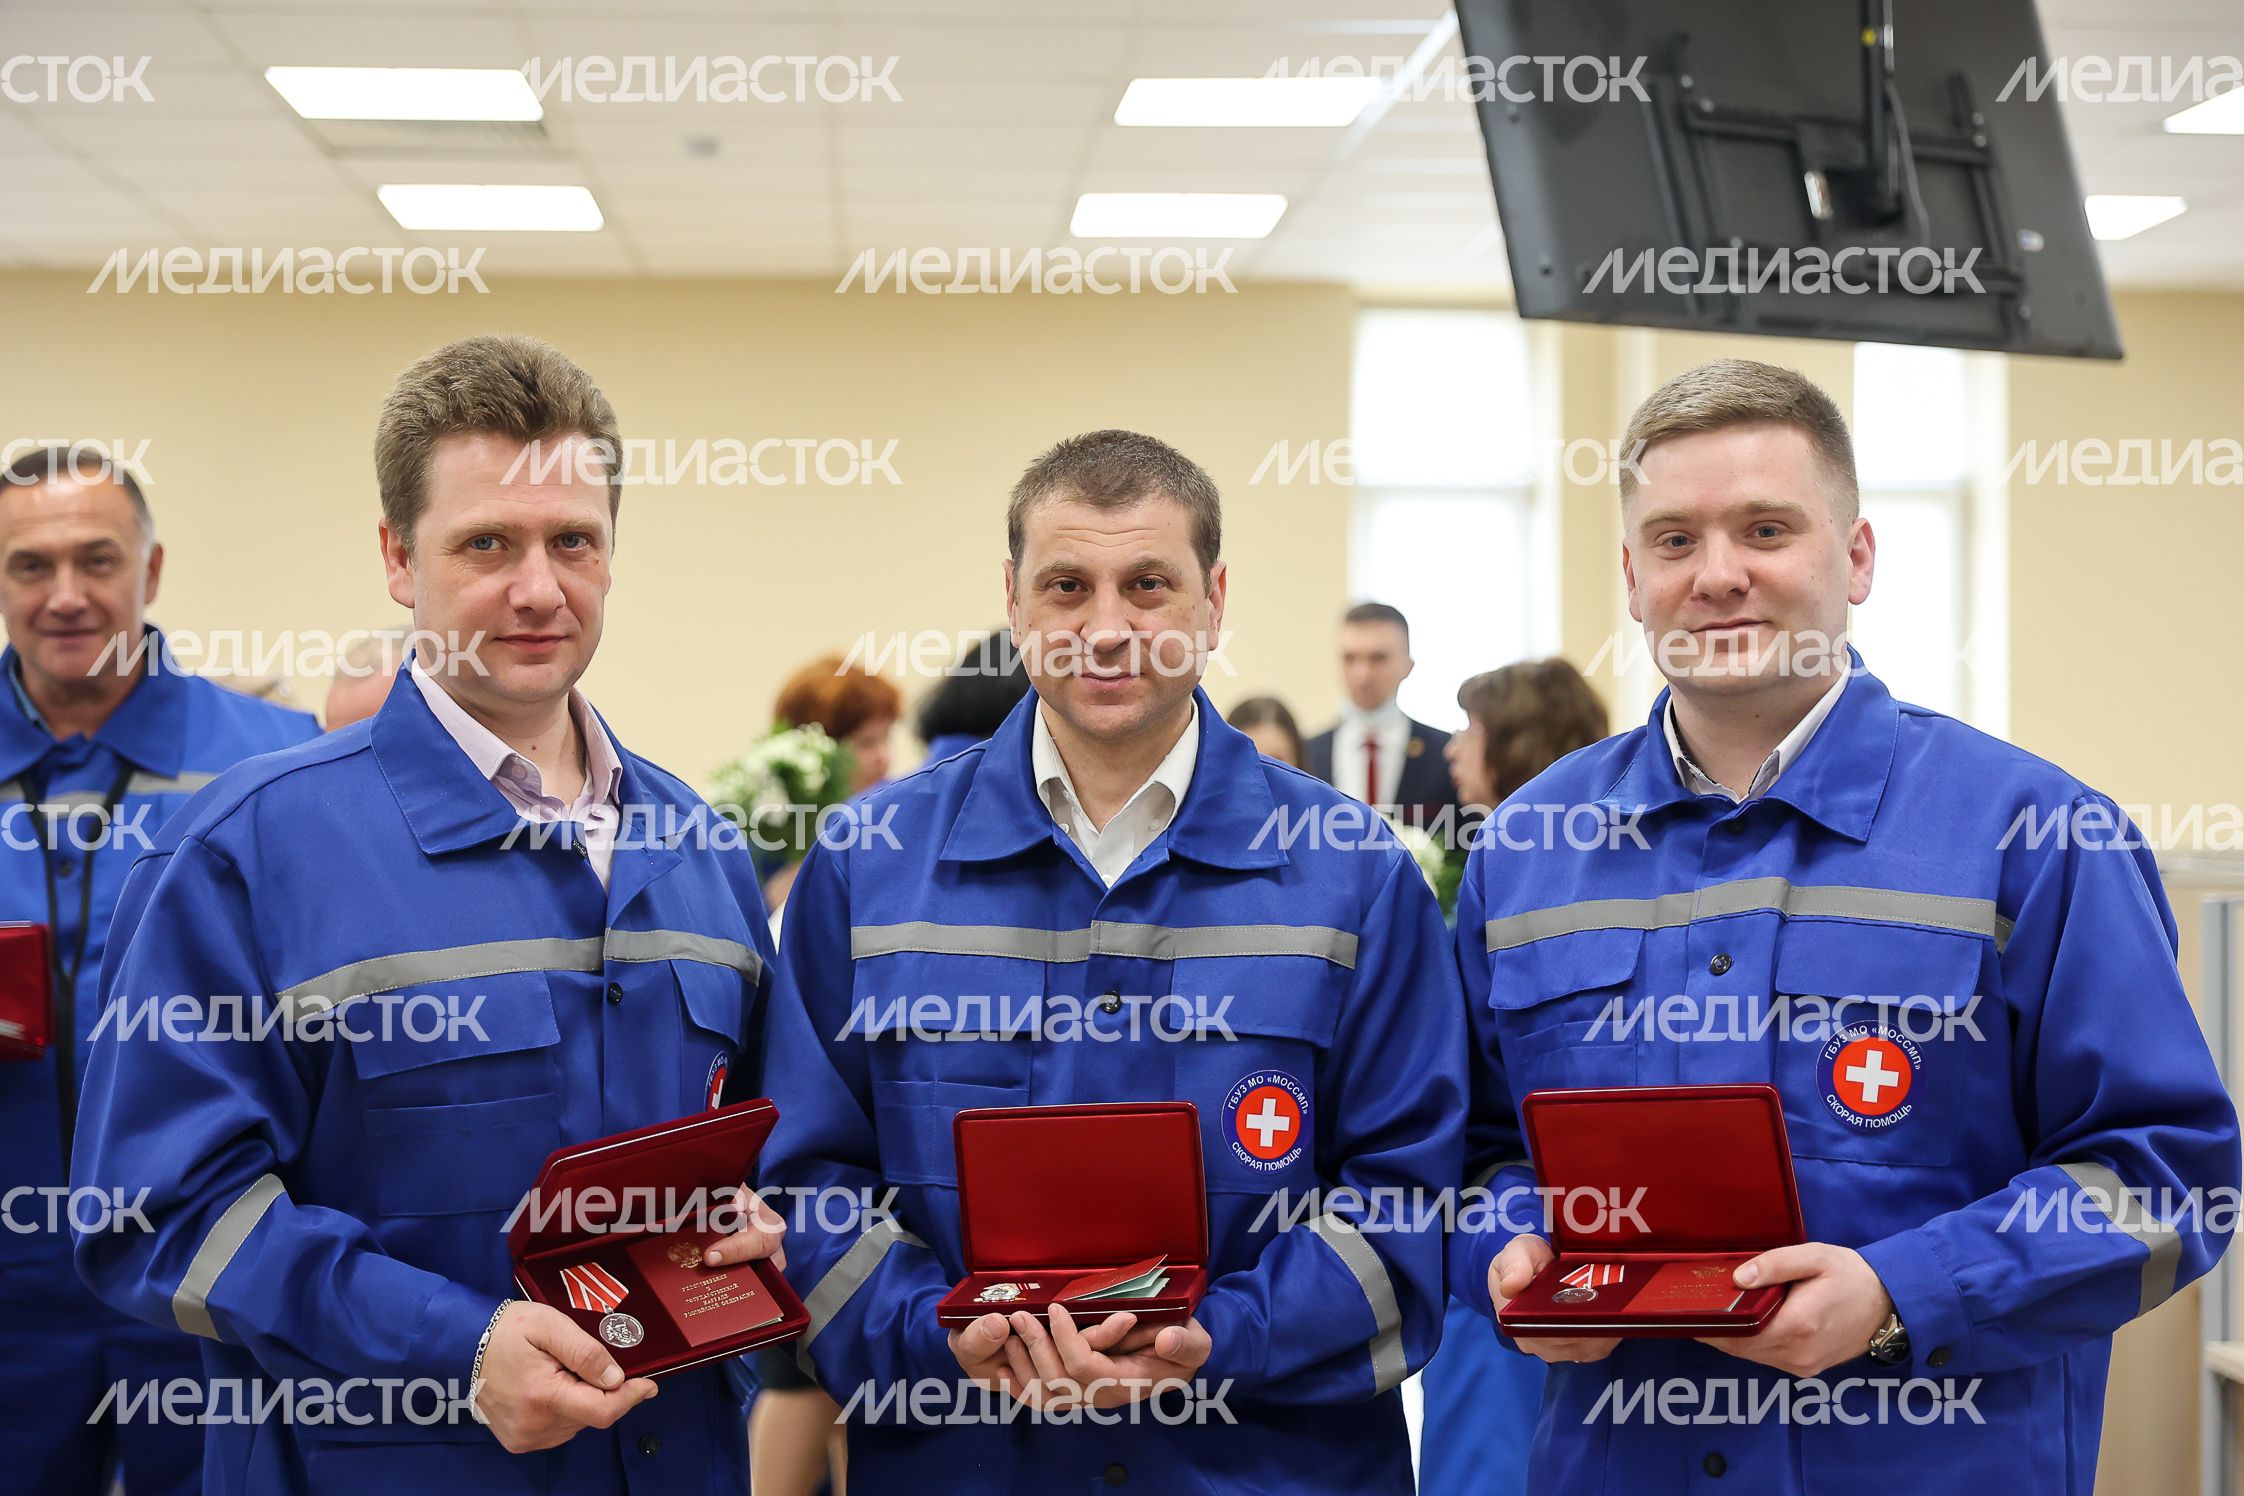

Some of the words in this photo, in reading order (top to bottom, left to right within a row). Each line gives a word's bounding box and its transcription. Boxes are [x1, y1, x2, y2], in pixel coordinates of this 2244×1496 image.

[1824, 1034, 1848, 1060] ГБУЗ
[1849, 1025, 1868, 1038] МО
[1871, 1025, 1922, 1070] «МОССМП»
[1227, 1084, 1248, 1110] ГБУЗ
[1248, 1075, 1264, 1088] МО
[1266, 1074, 1309, 1115] «МОССМП»
[1826, 1094, 1863, 1127] СКОРАЯ
[1865, 1104, 1912, 1128] ПОМОЩЬ
[1232, 1141, 1263, 1171] СКОРАЯ
[1264, 1147, 1302, 1171] ПОМОЩЬ
